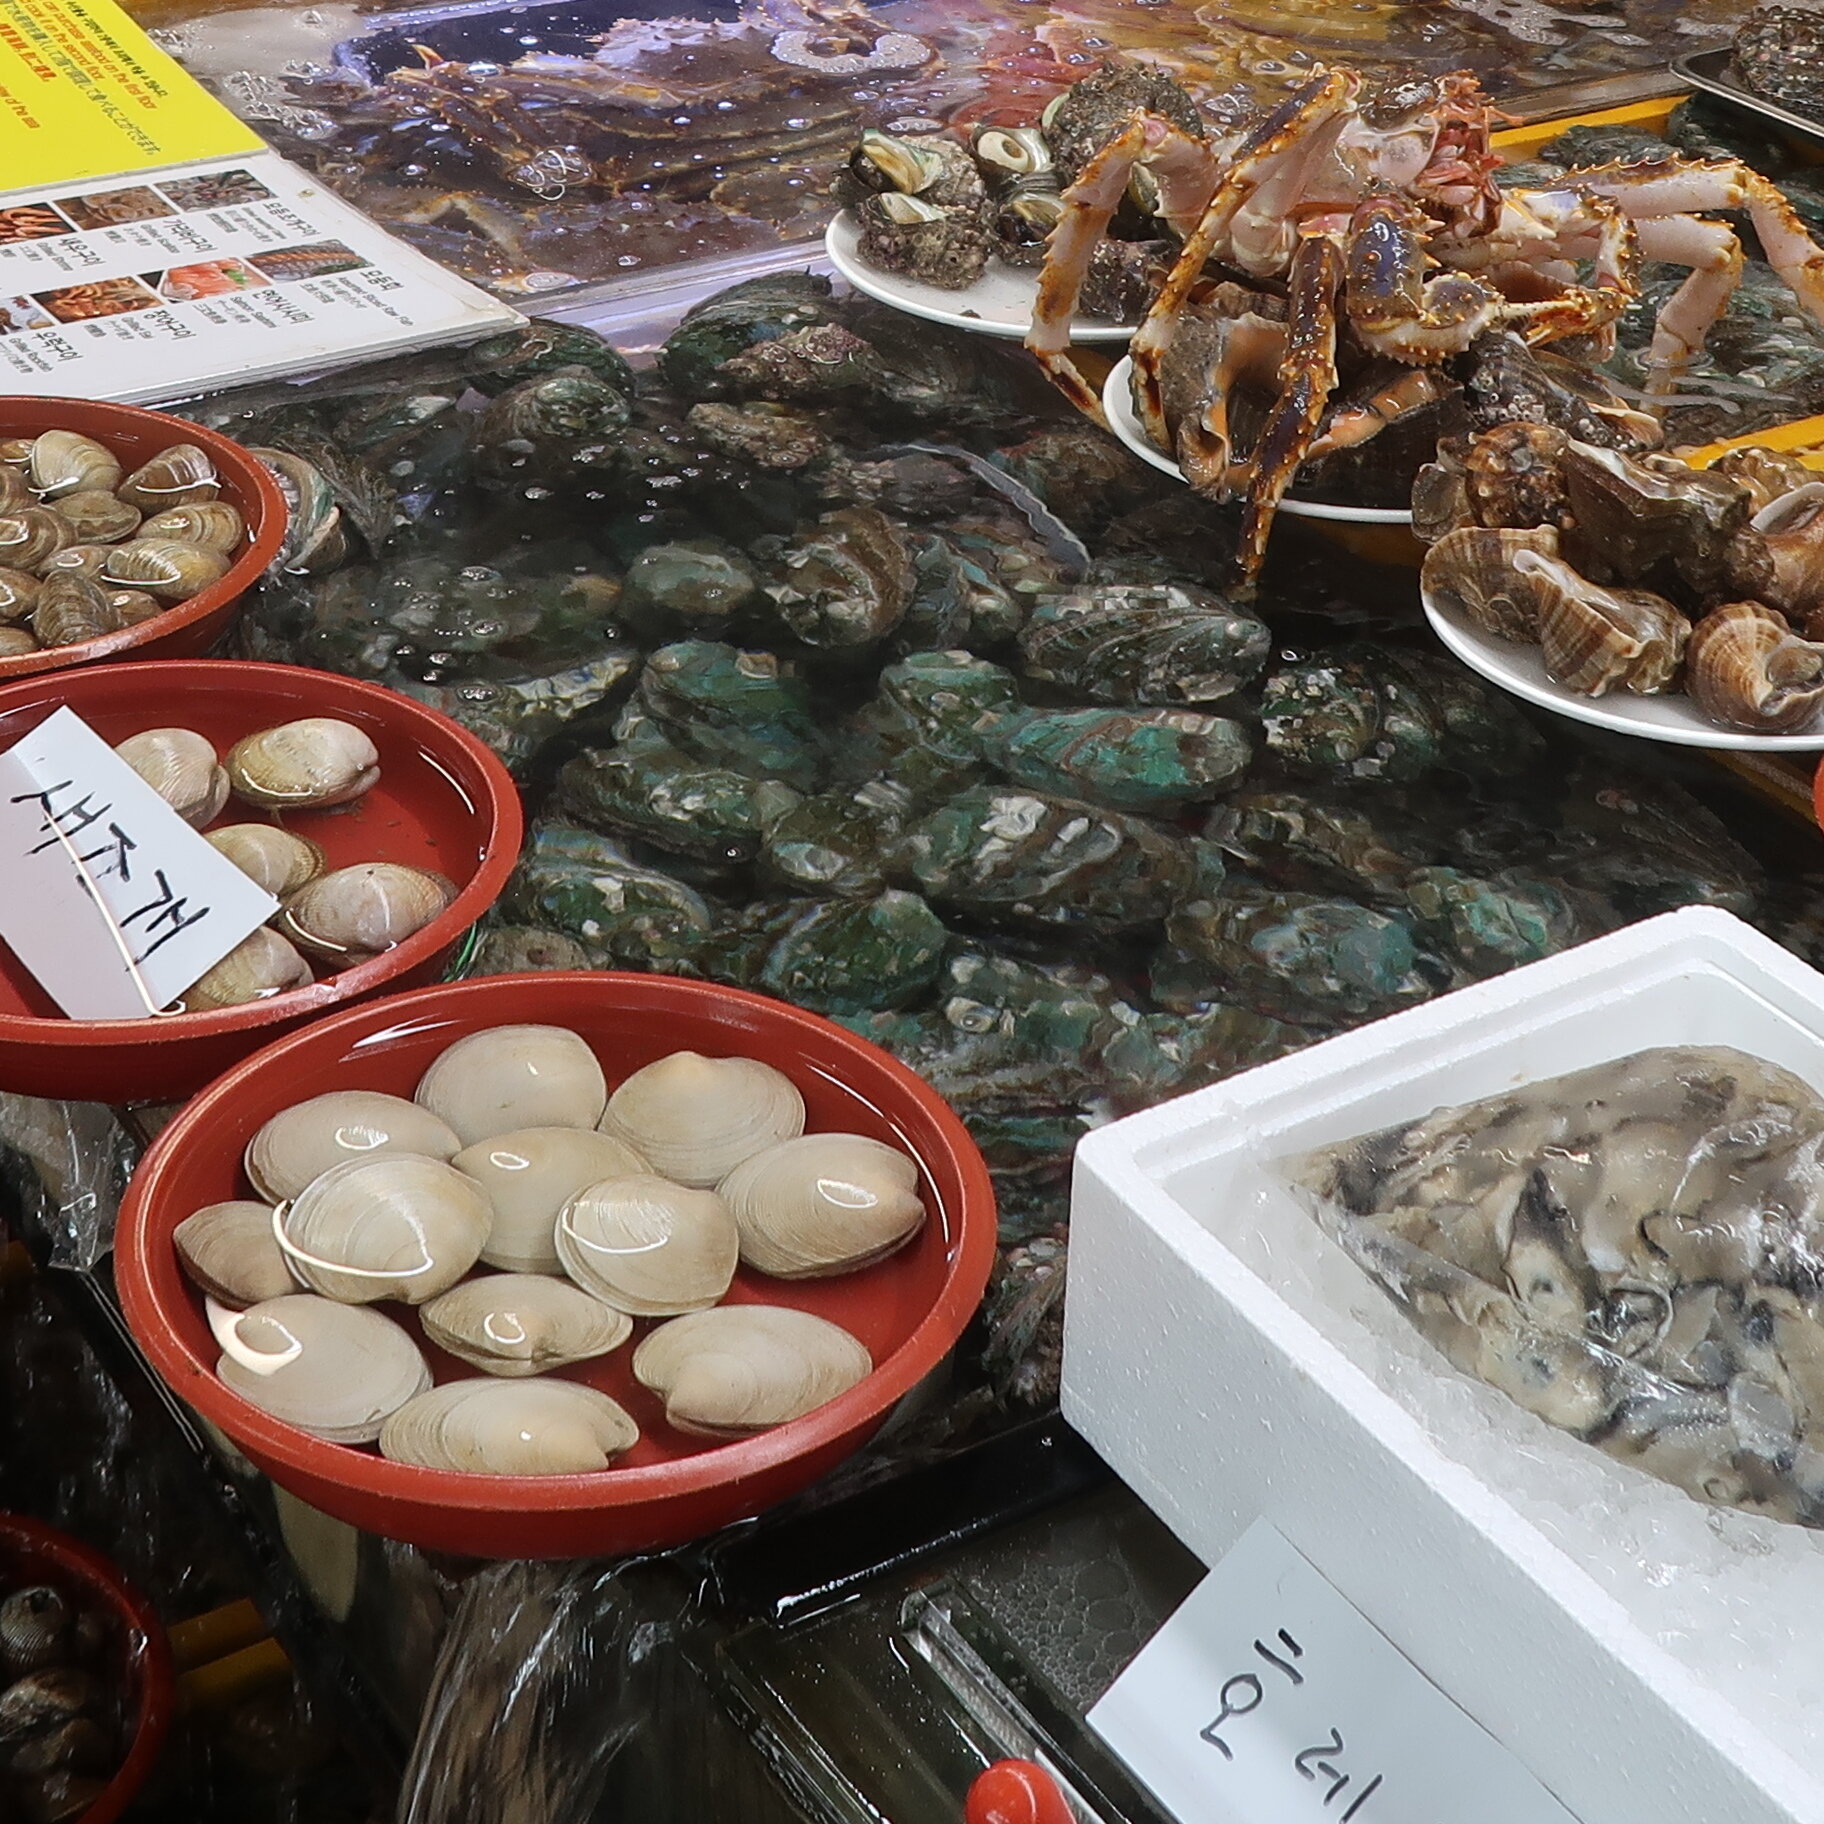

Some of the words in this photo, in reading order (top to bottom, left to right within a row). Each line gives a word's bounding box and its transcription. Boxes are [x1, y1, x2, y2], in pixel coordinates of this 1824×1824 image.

[61, 235, 106, 267] 새우구이
[145, 309, 196, 341] 장어구이
[33, 329, 82, 362] 우럭구이
[9, 779, 212, 974] 새조개
